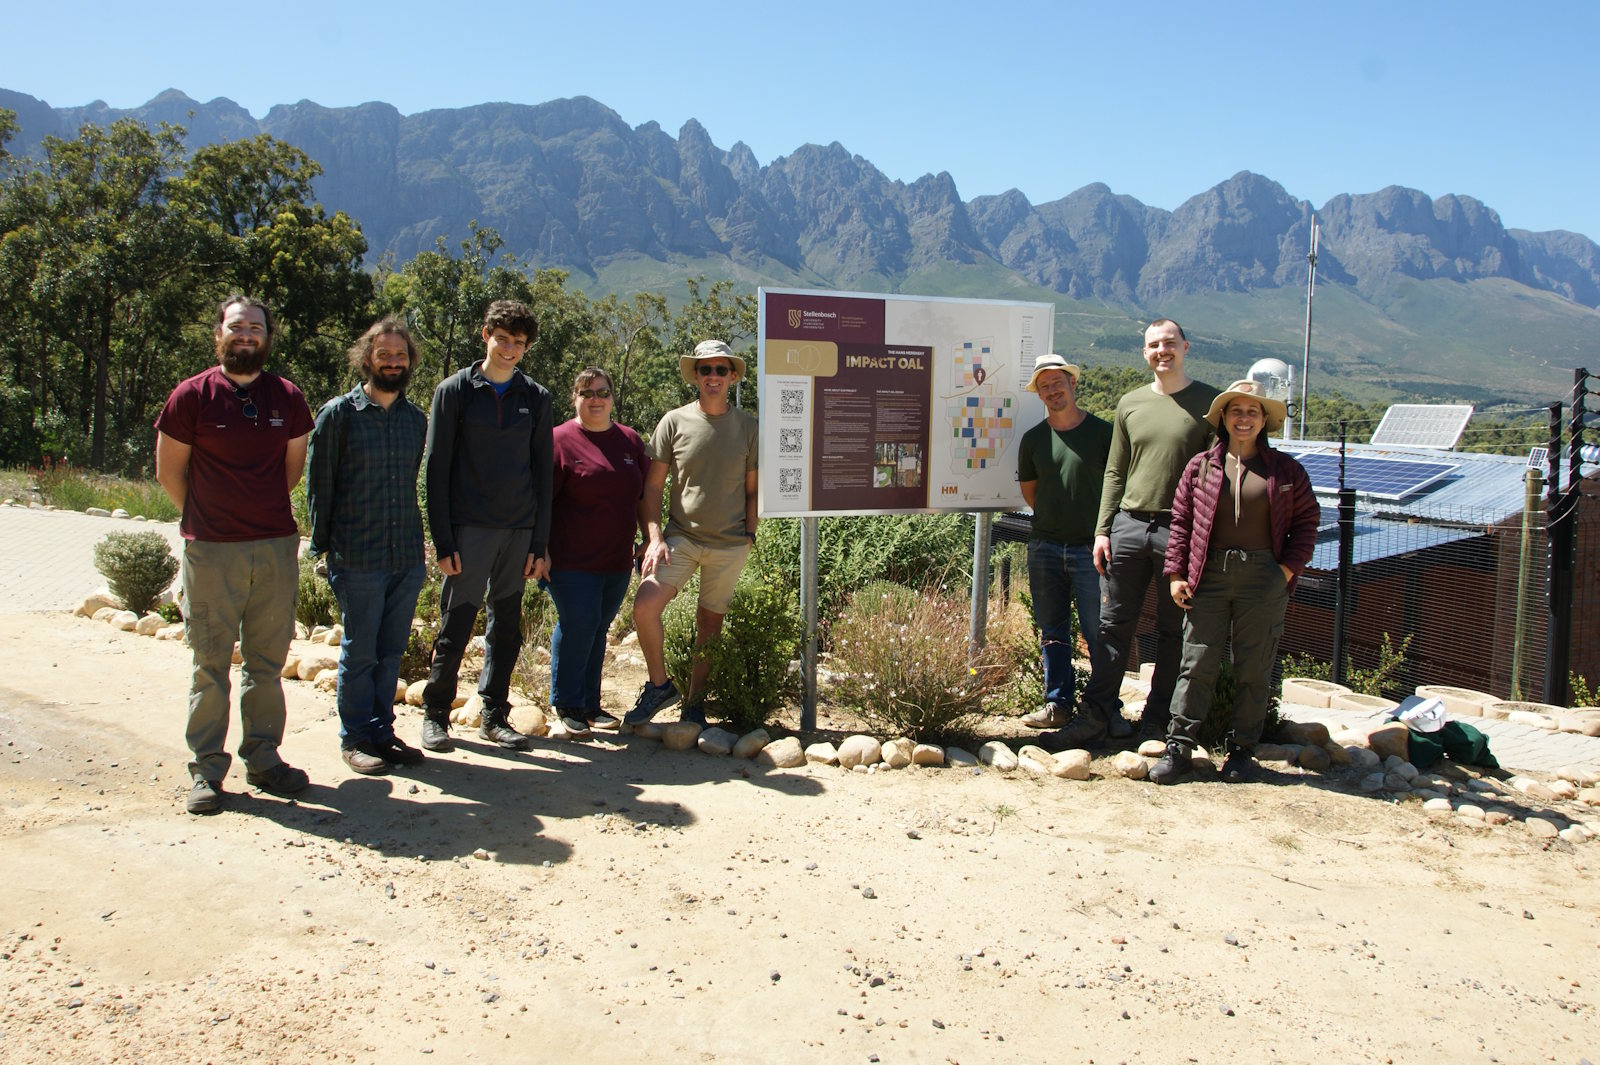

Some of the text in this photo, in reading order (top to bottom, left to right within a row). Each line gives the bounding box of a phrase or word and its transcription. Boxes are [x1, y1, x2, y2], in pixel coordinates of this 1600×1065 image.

[803, 310, 837, 318] Stellenbosch
[846, 355, 924, 370] IMPACT OAL
[942, 486, 958, 494] HM
